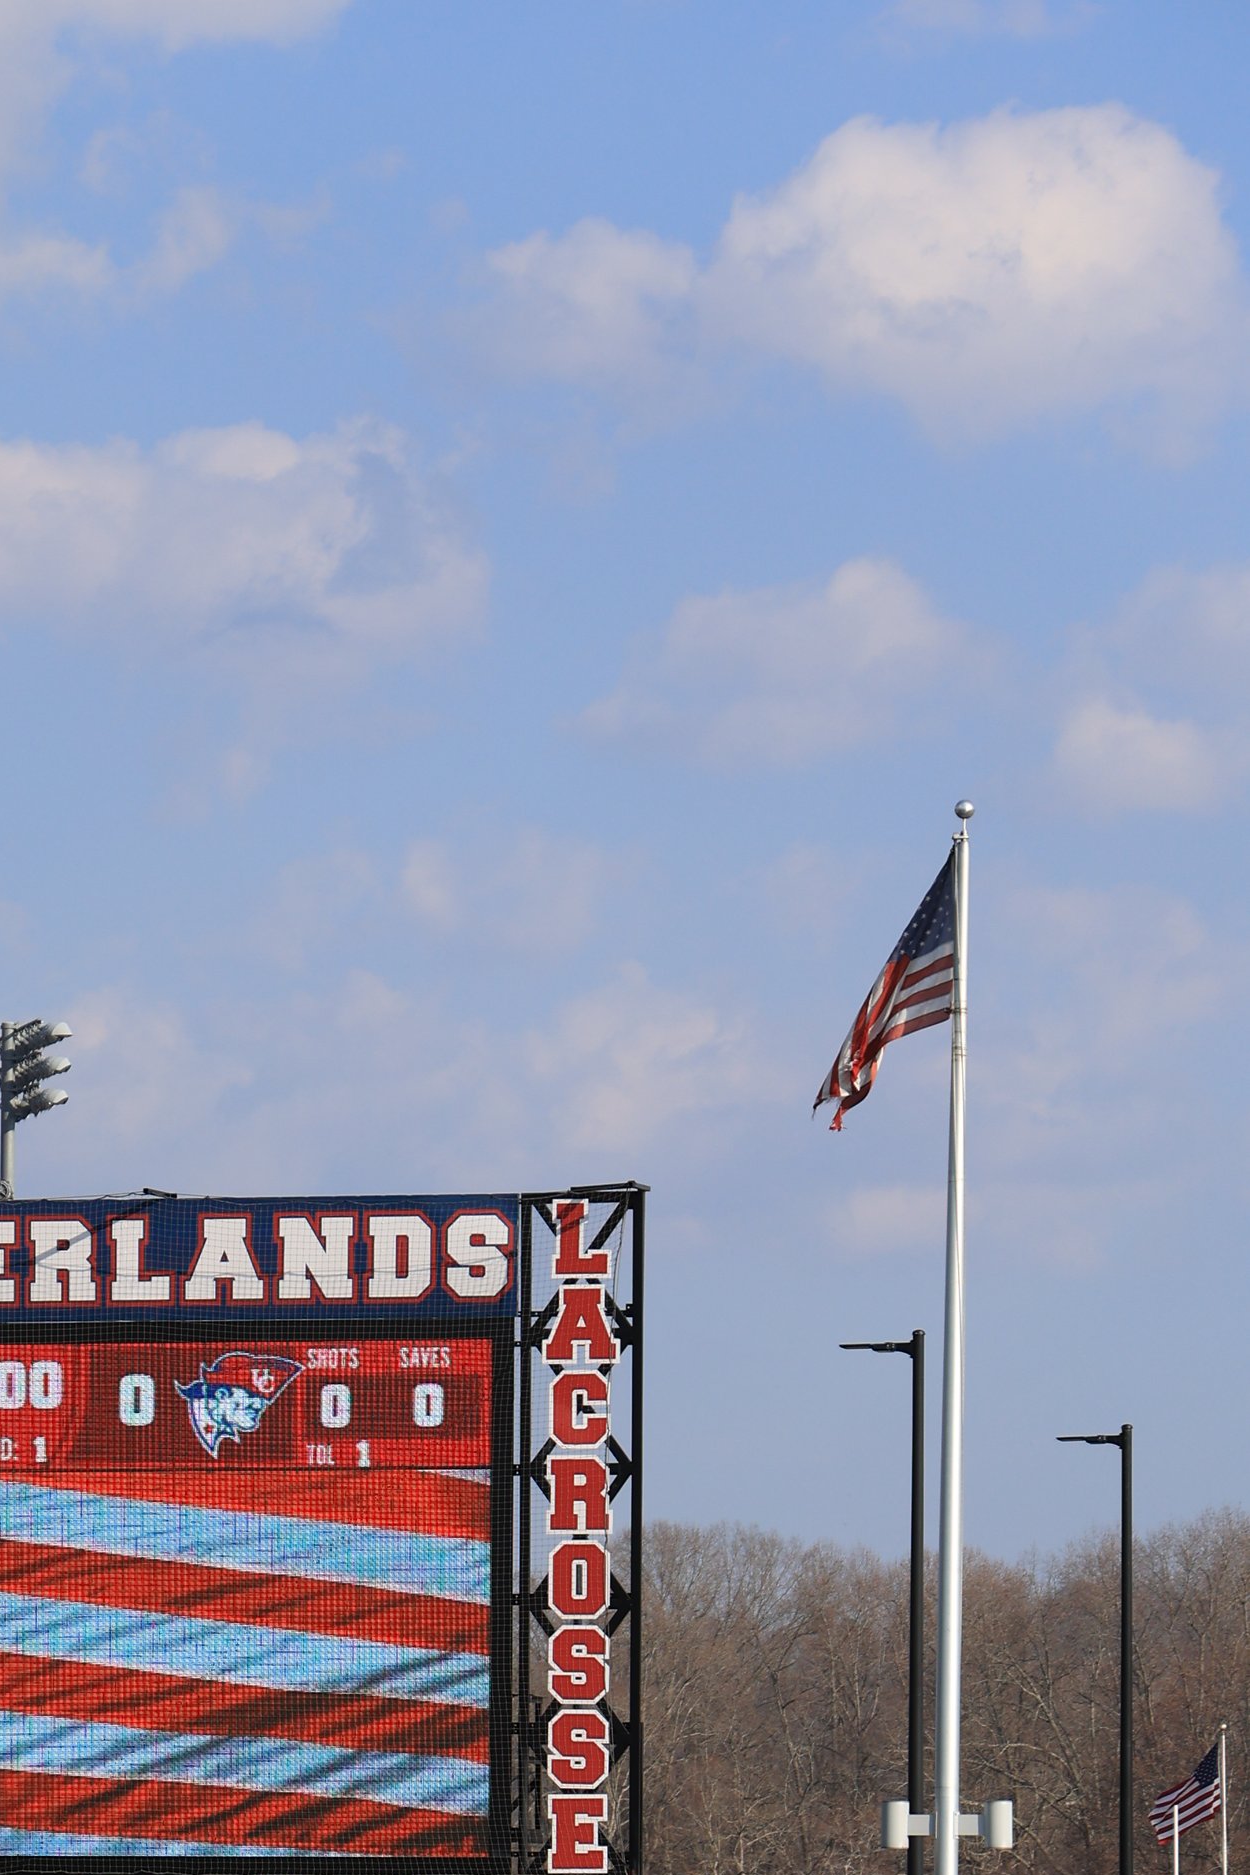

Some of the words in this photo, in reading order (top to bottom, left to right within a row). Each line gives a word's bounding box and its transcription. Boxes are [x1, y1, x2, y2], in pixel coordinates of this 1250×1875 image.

[307, 1348, 360, 1369] SHOTS
[400, 1347, 450, 1368] SAVES
[119, 1373, 155, 1427] 0
[321, 1383, 351, 1428] 0
[414, 1383, 444, 1427] 0
[33, 1436, 47, 1463] 1
[307, 1444, 335, 1465] TOL
[356, 1440, 370, 1468] 1
[542, 1198, 620, 1873] LACROSSE
